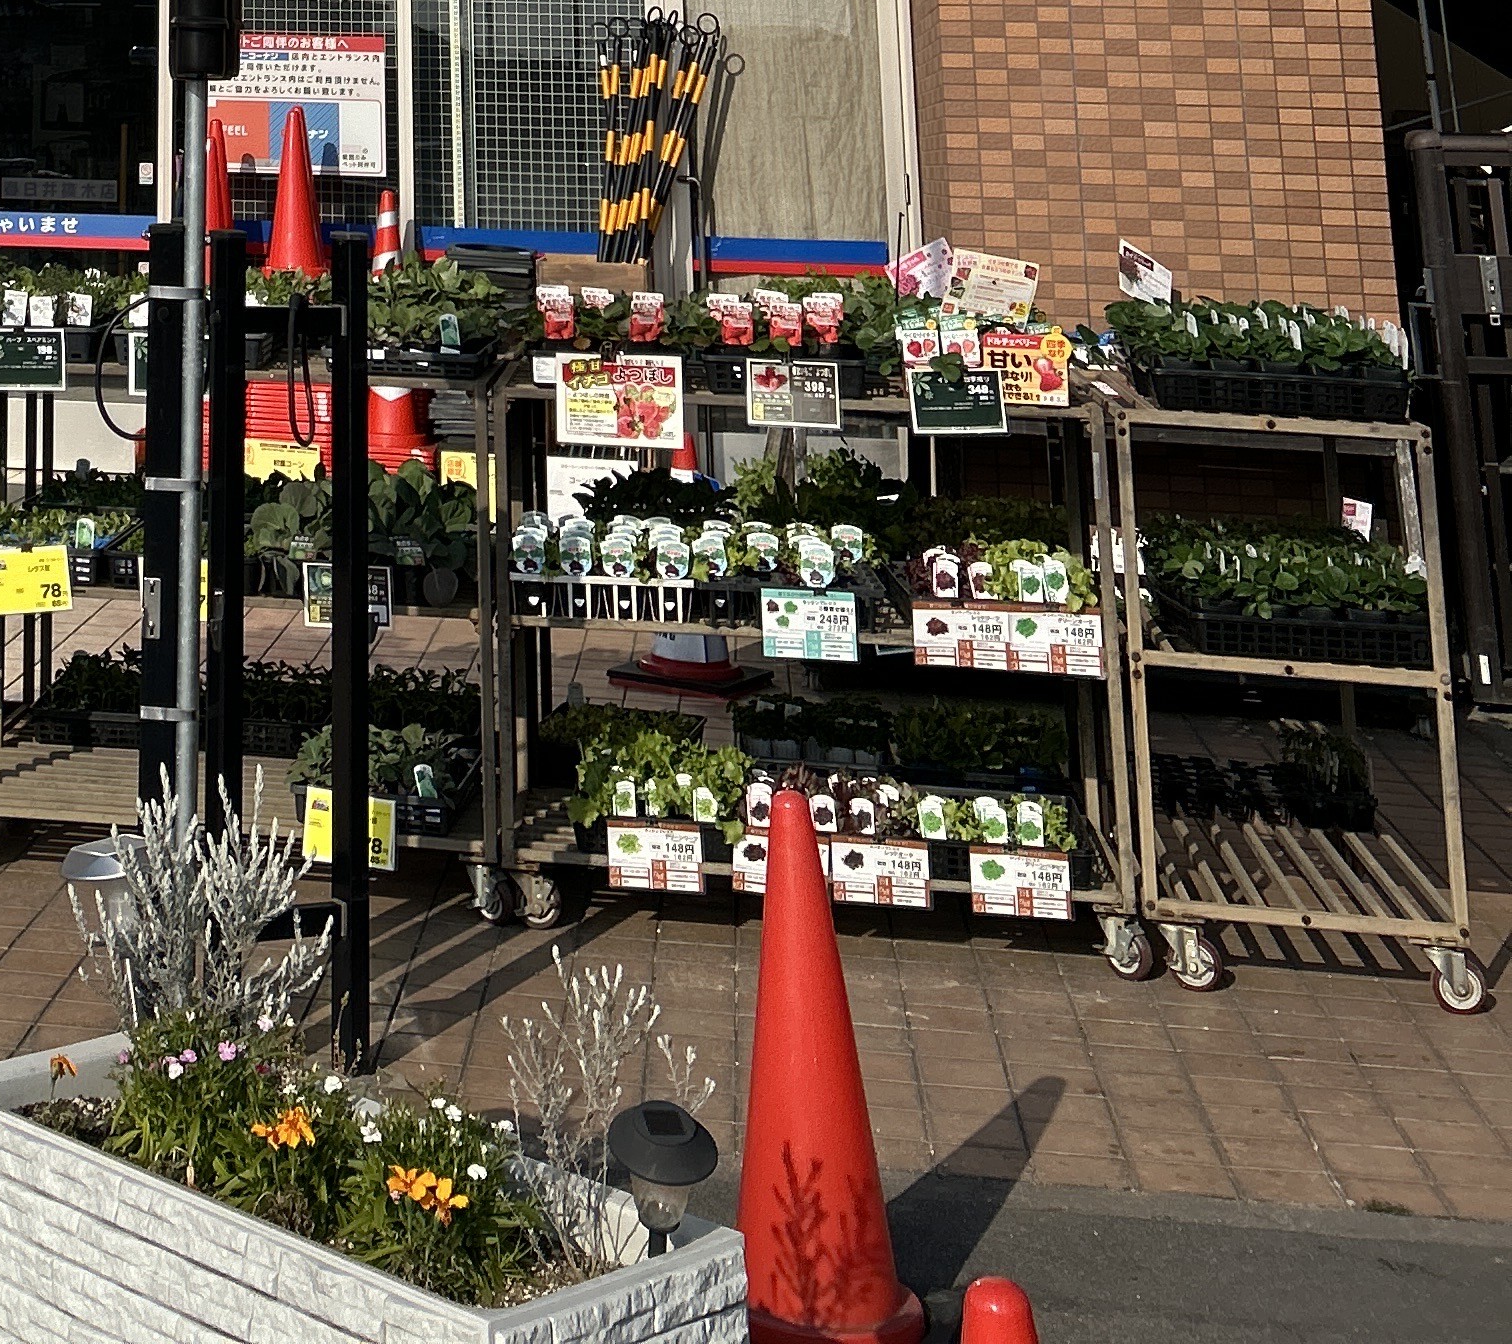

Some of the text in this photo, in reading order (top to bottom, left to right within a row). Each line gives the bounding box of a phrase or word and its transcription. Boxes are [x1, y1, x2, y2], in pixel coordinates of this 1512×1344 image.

[240, 36, 349, 50] トご同伴のお客様へ
[988, 349, 1032, 368] 甘い
[566, 372, 610, 391] イチゴ
[613, 367, 673, 384] よつぼし
[972, 624, 1095, 638] 148円 148円
[665, 843, 694, 855] 148円
[891, 859, 921, 872] 148円
[1031, 871, 1062, 883] 148円
